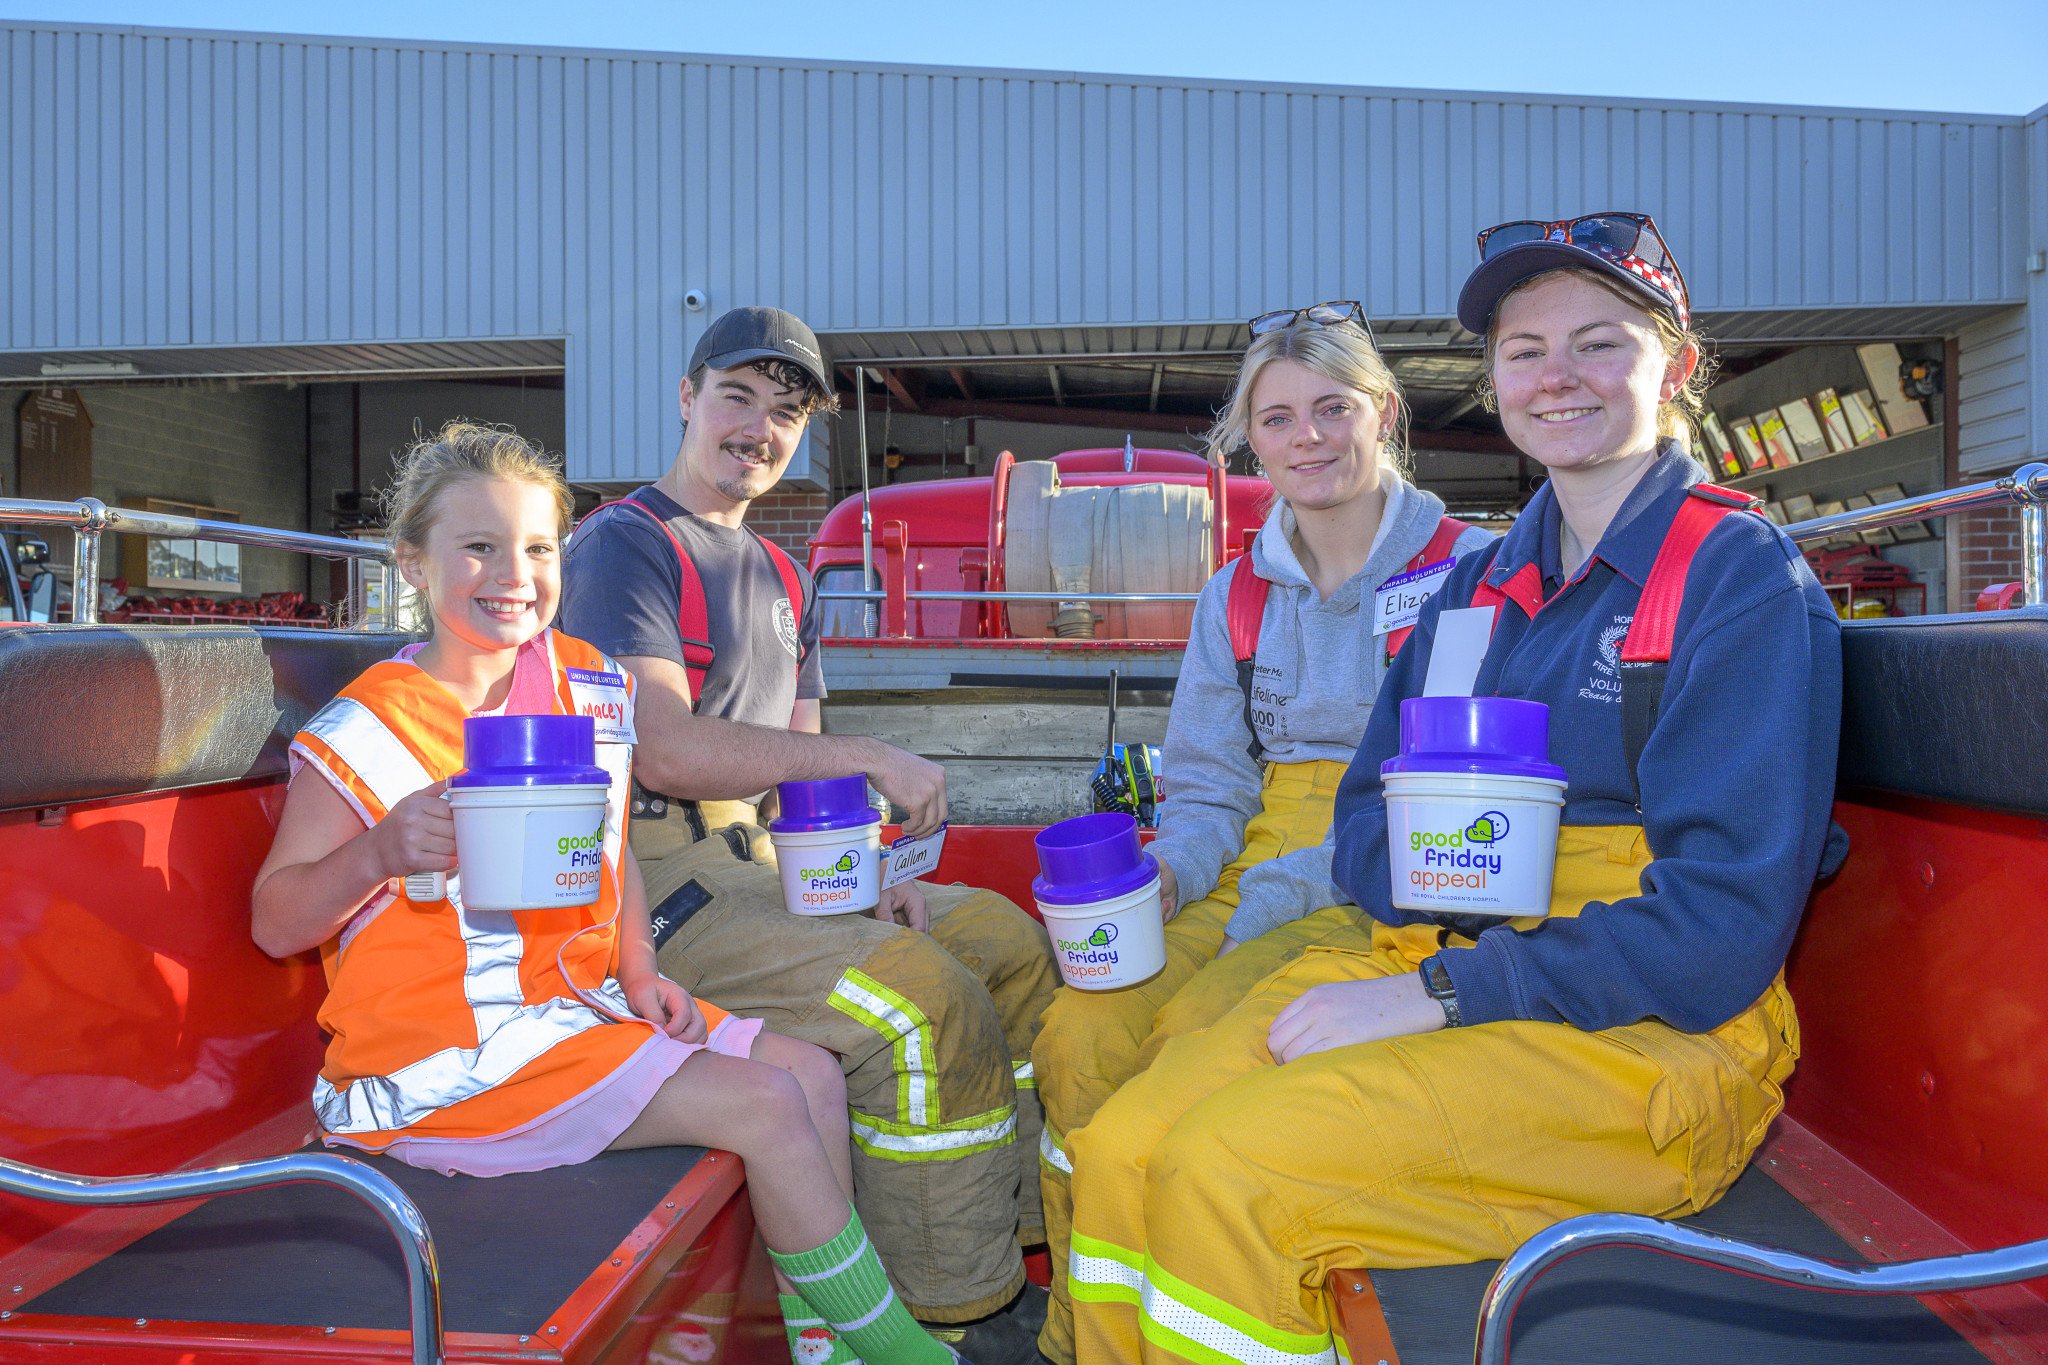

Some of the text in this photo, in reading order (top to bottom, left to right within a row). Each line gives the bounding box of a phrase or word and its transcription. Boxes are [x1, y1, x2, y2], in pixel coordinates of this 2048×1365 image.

[1381, 562, 1451, 589] UNPAID VOLUNTEER
[1253, 665, 1271, 675] eter
[1592, 660, 1614, 676] FIRE
[570, 672, 621, 685] UNPAID VOLUNTEER
[1251, 686, 1287, 706] ifeline
[1578, 688, 1612, 703] Ready
[582, 702, 624, 728] Macey
[557, 830, 597, 855] good
[1410, 829, 1463, 851] good
[894, 847, 928, 872] Callum
[1425, 848, 1501, 875] friday
[799, 864, 835, 881] good
[1410, 870, 1486, 891] appeal
[811, 876, 858, 890] friday
[802, 887, 851, 906] appeal
[1057, 938, 1089, 952] good
[1068, 949, 1118, 964] friday
[1063, 962, 1112, 979] appeal
